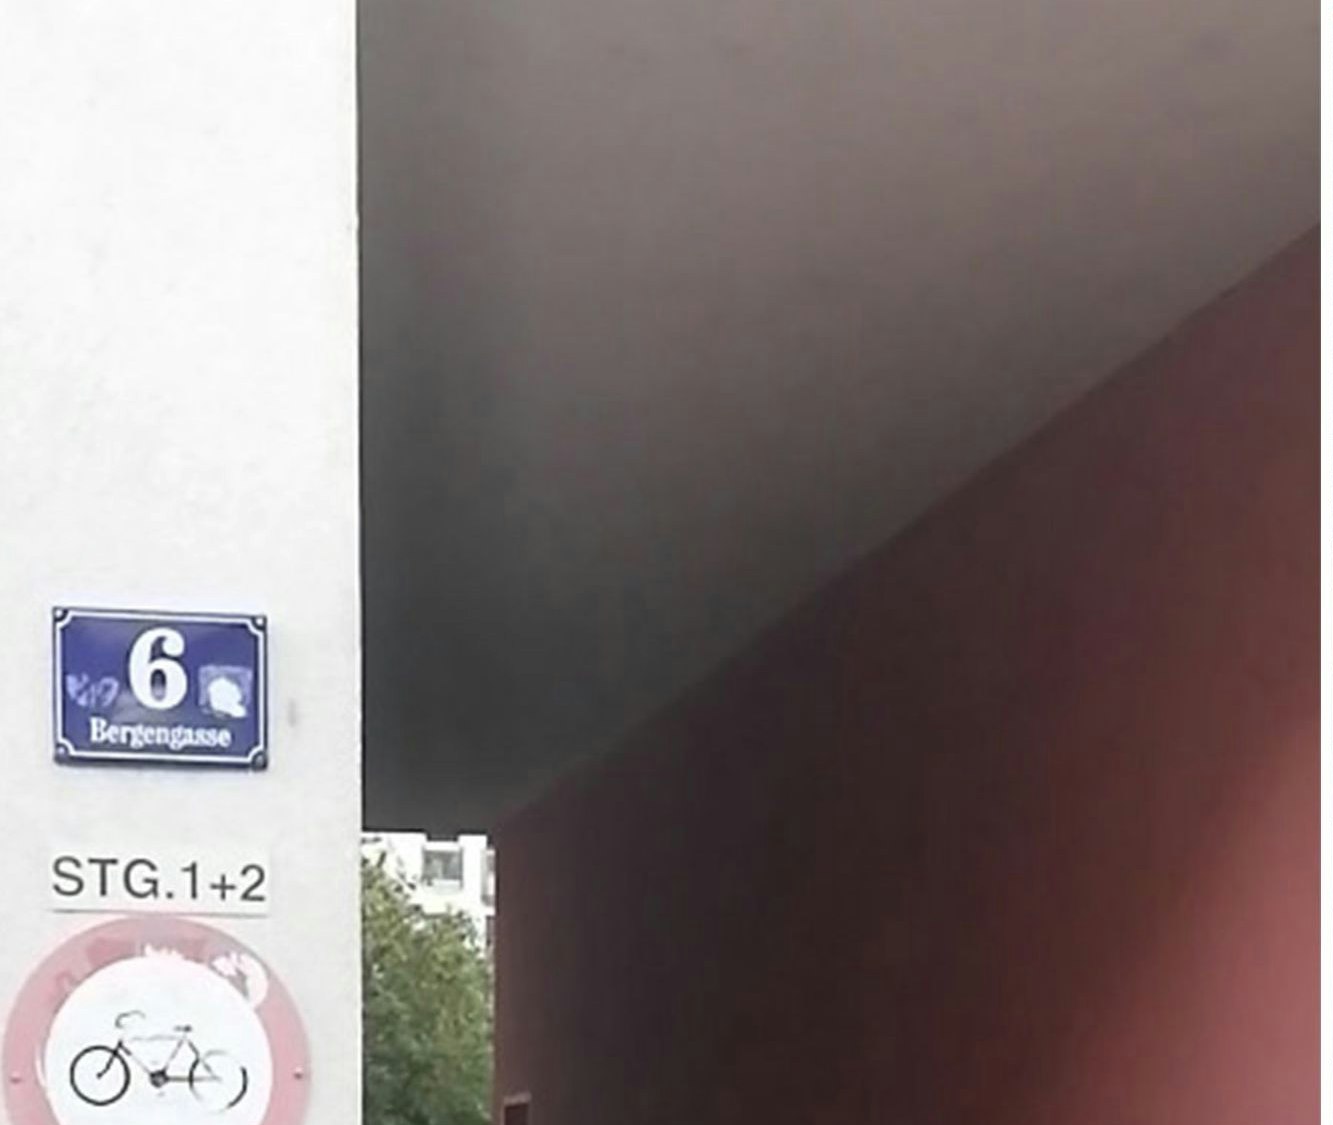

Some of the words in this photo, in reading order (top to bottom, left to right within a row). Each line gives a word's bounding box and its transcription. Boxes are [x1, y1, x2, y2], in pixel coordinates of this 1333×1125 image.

[128, 626, 189, 710] 6
[89, 716, 232, 749] Bergengasse
[51, 855, 266, 902] STG.1+2
